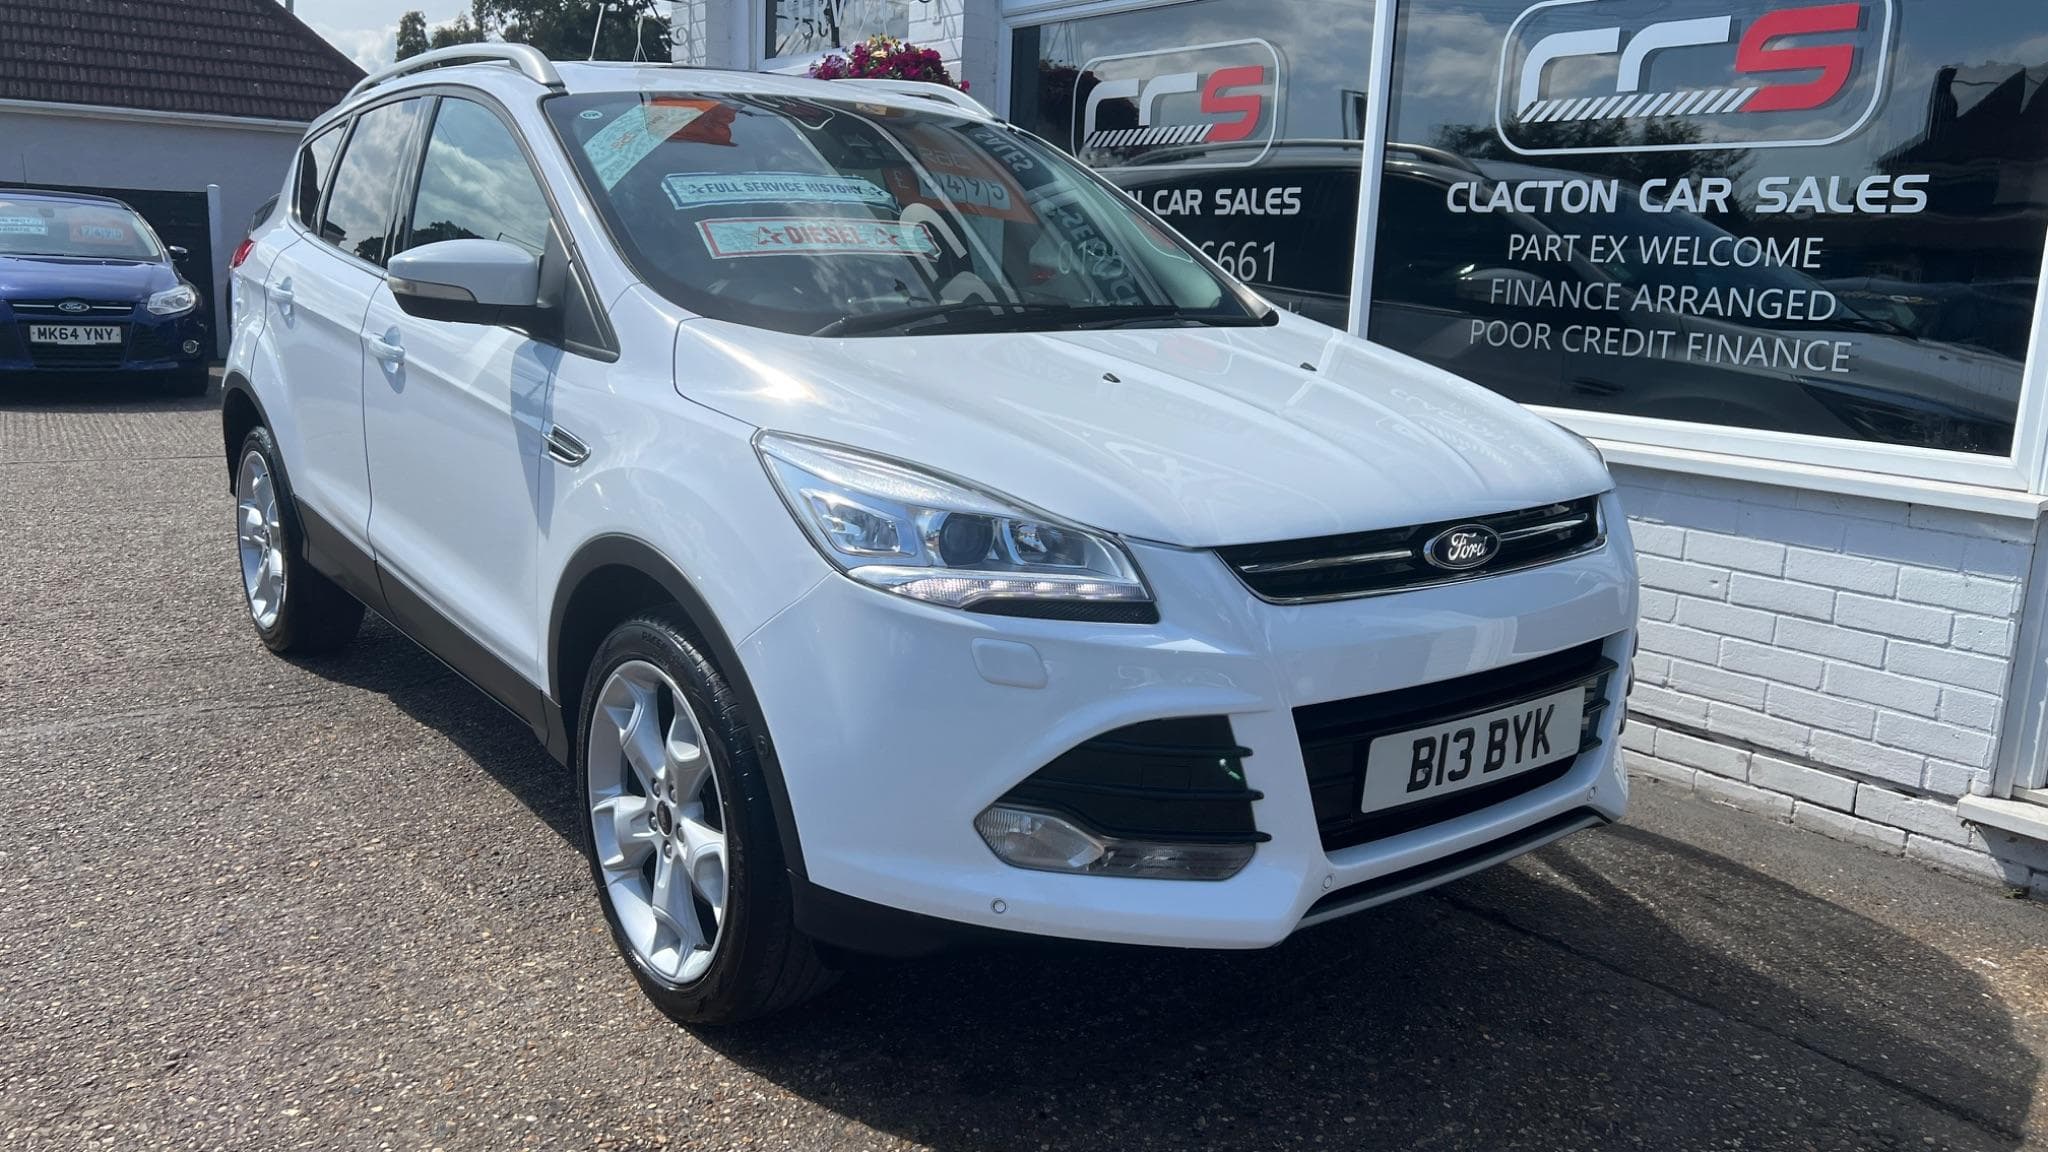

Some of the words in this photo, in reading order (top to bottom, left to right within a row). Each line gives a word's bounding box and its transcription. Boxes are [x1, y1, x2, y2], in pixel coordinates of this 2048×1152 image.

[706, 183, 741, 194] FULL
[744, 182, 805, 193] SERVICE
[806, 183, 862, 195] HISTORY
[1153, 189, 1203, 216] CAR
[1214, 187, 1302, 216] SALES
[1446, 178, 1619, 214] CLACTON
[1638, 177, 1732, 214] CAR
[1754, 173, 1930, 214] SALES
[783, 225, 868, 245] DIESEL
[1508, 234, 1580, 262] PART
[1590, 235, 1628, 263] EX
[1639, 235, 1824, 268] WELCOME
[1490, 278, 1622, 311] FINANCE
[1630, 284, 1837, 321] ARRANGED
[37, 327, 79, 341] MK64
[83, 327, 113, 341] YNY
[1470, 319, 1552, 350] POOR
[1562, 325, 1676, 359] CREDIT
[1687, 332, 1852, 373] FINANCE
[1447, 532, 1488, 561] Ford
[1406, 727, 1475, 794] B13
[1483, 703, 1555, 774] BYK
